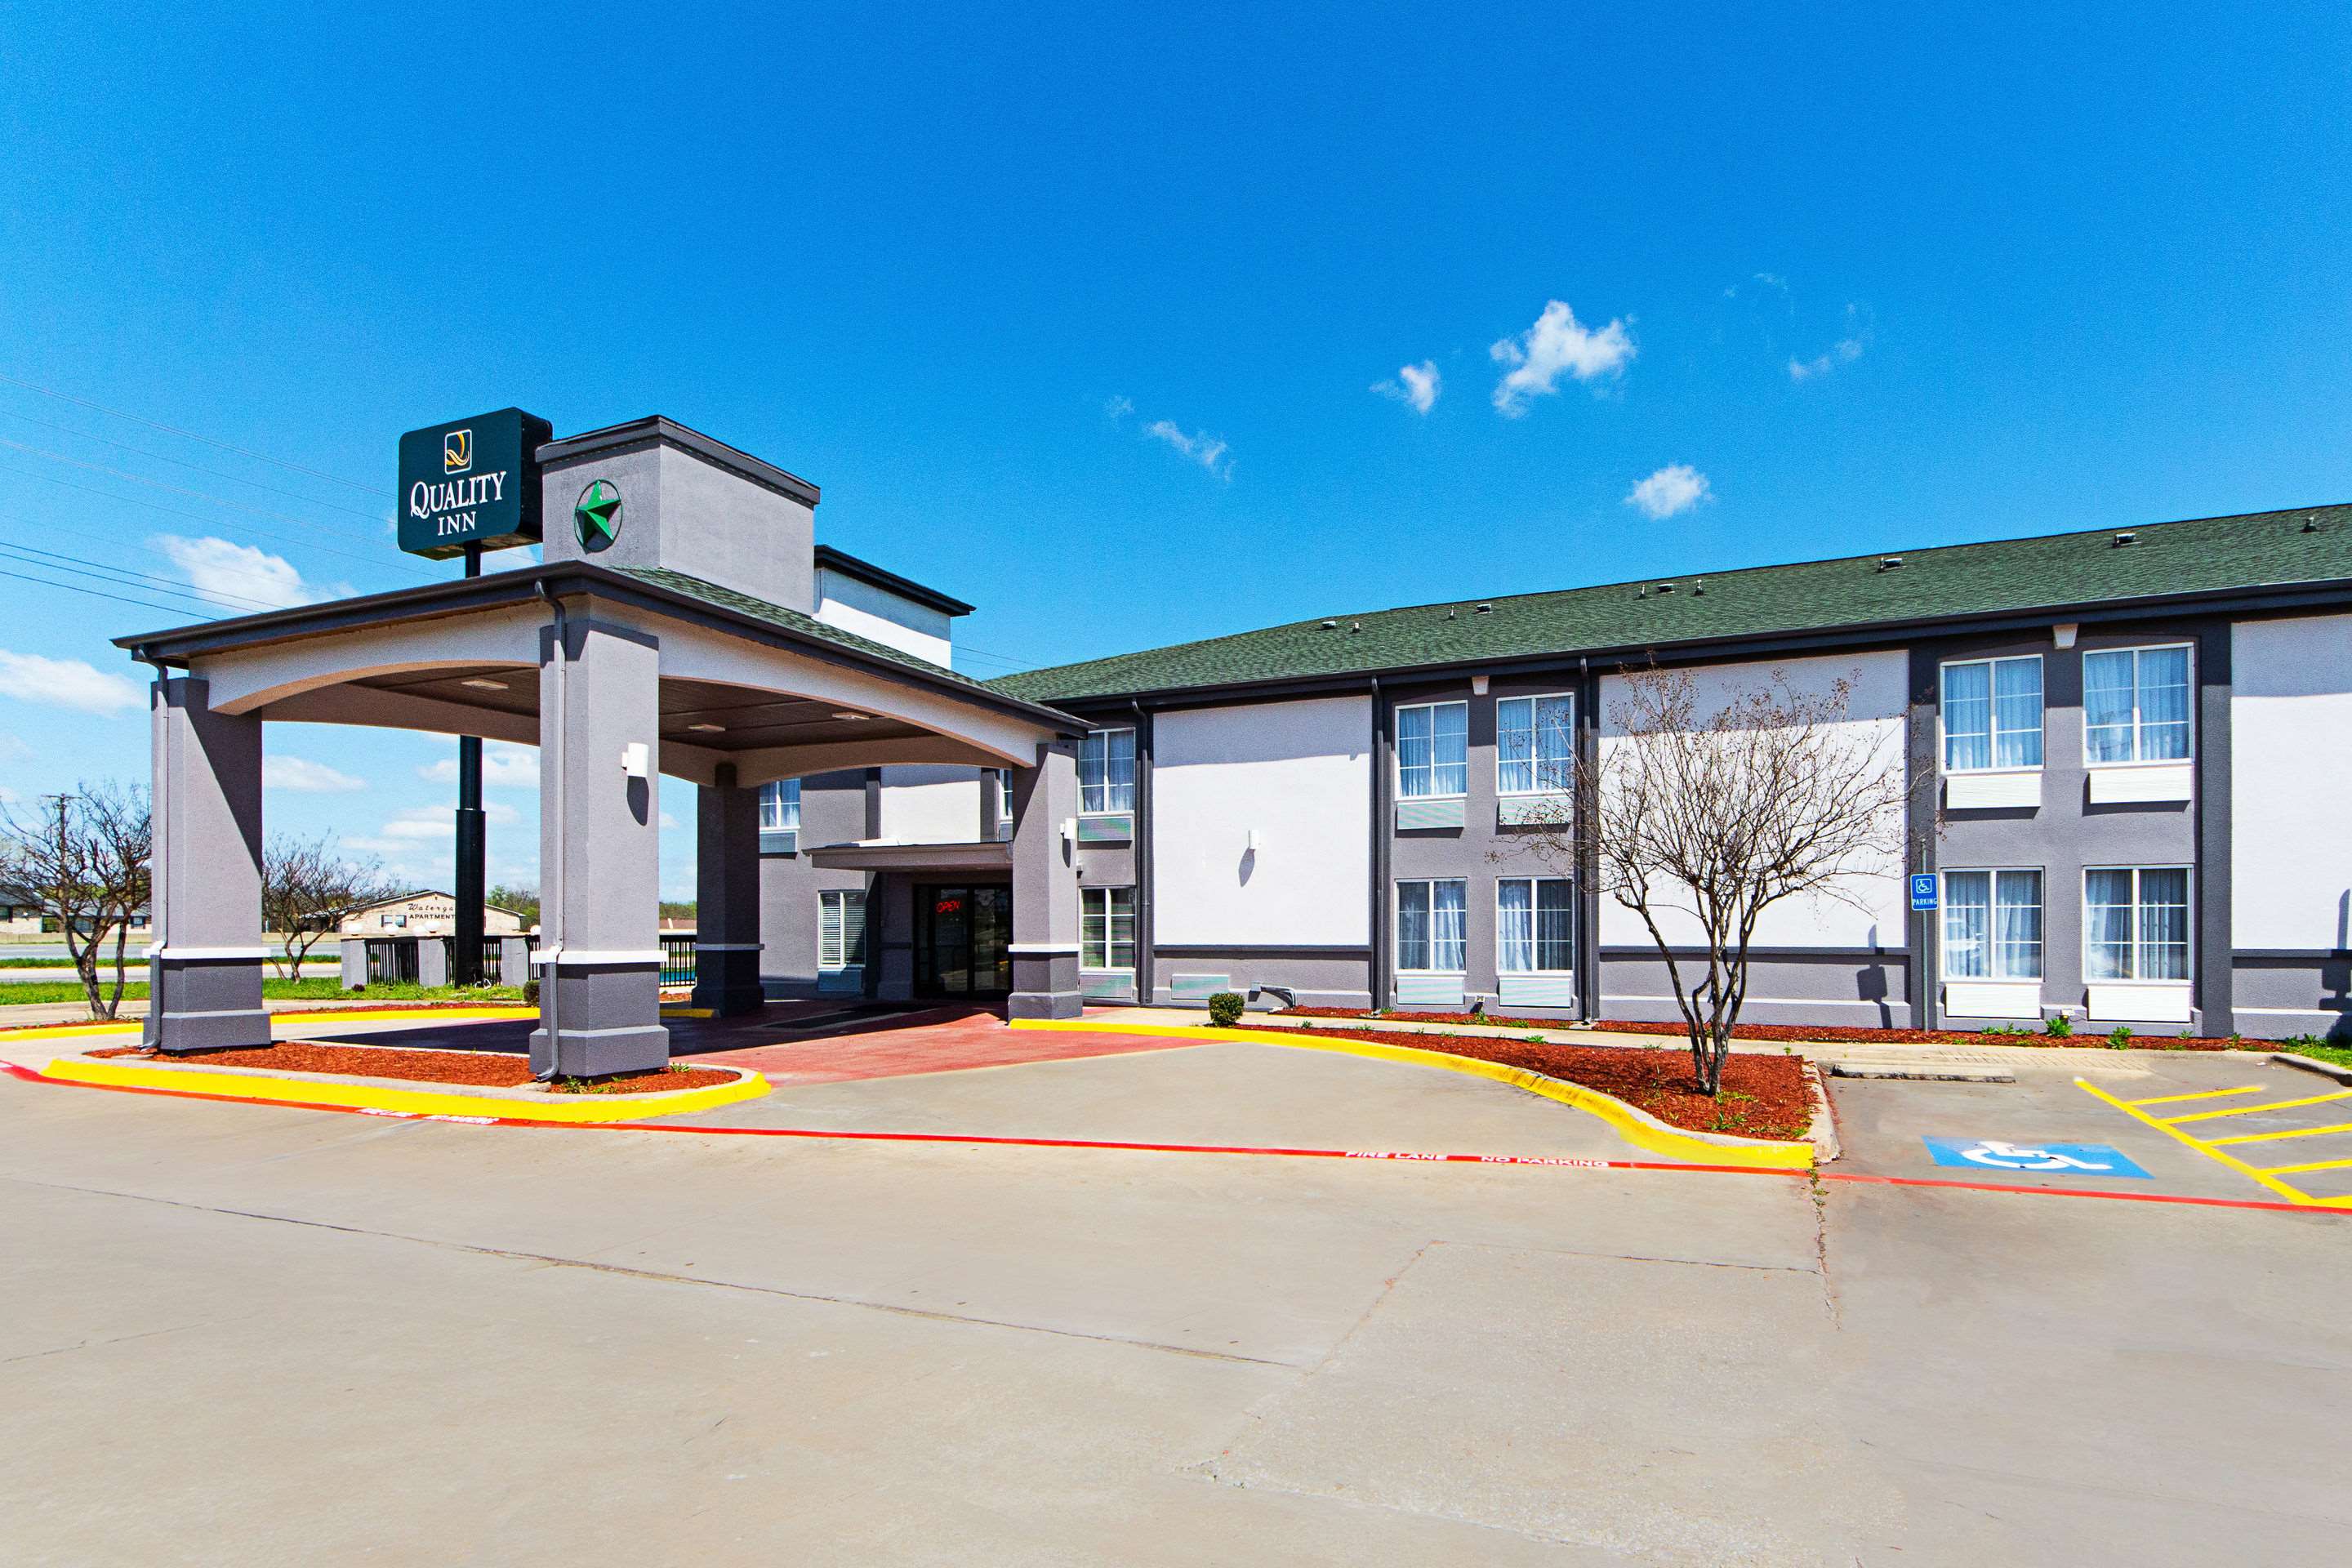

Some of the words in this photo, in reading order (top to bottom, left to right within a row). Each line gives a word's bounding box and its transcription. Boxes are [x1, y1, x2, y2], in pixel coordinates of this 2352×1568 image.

[410, 470, 507, 519] QUALITY
[437, 510, 477, 537] INN
[408, 903, 454, 912] Waterga
[936, 901, 960, 914] OPEN
[1395, 1152, 1448, 1160] LANE
[1517, 1156, 1610, 1168] PARKING
